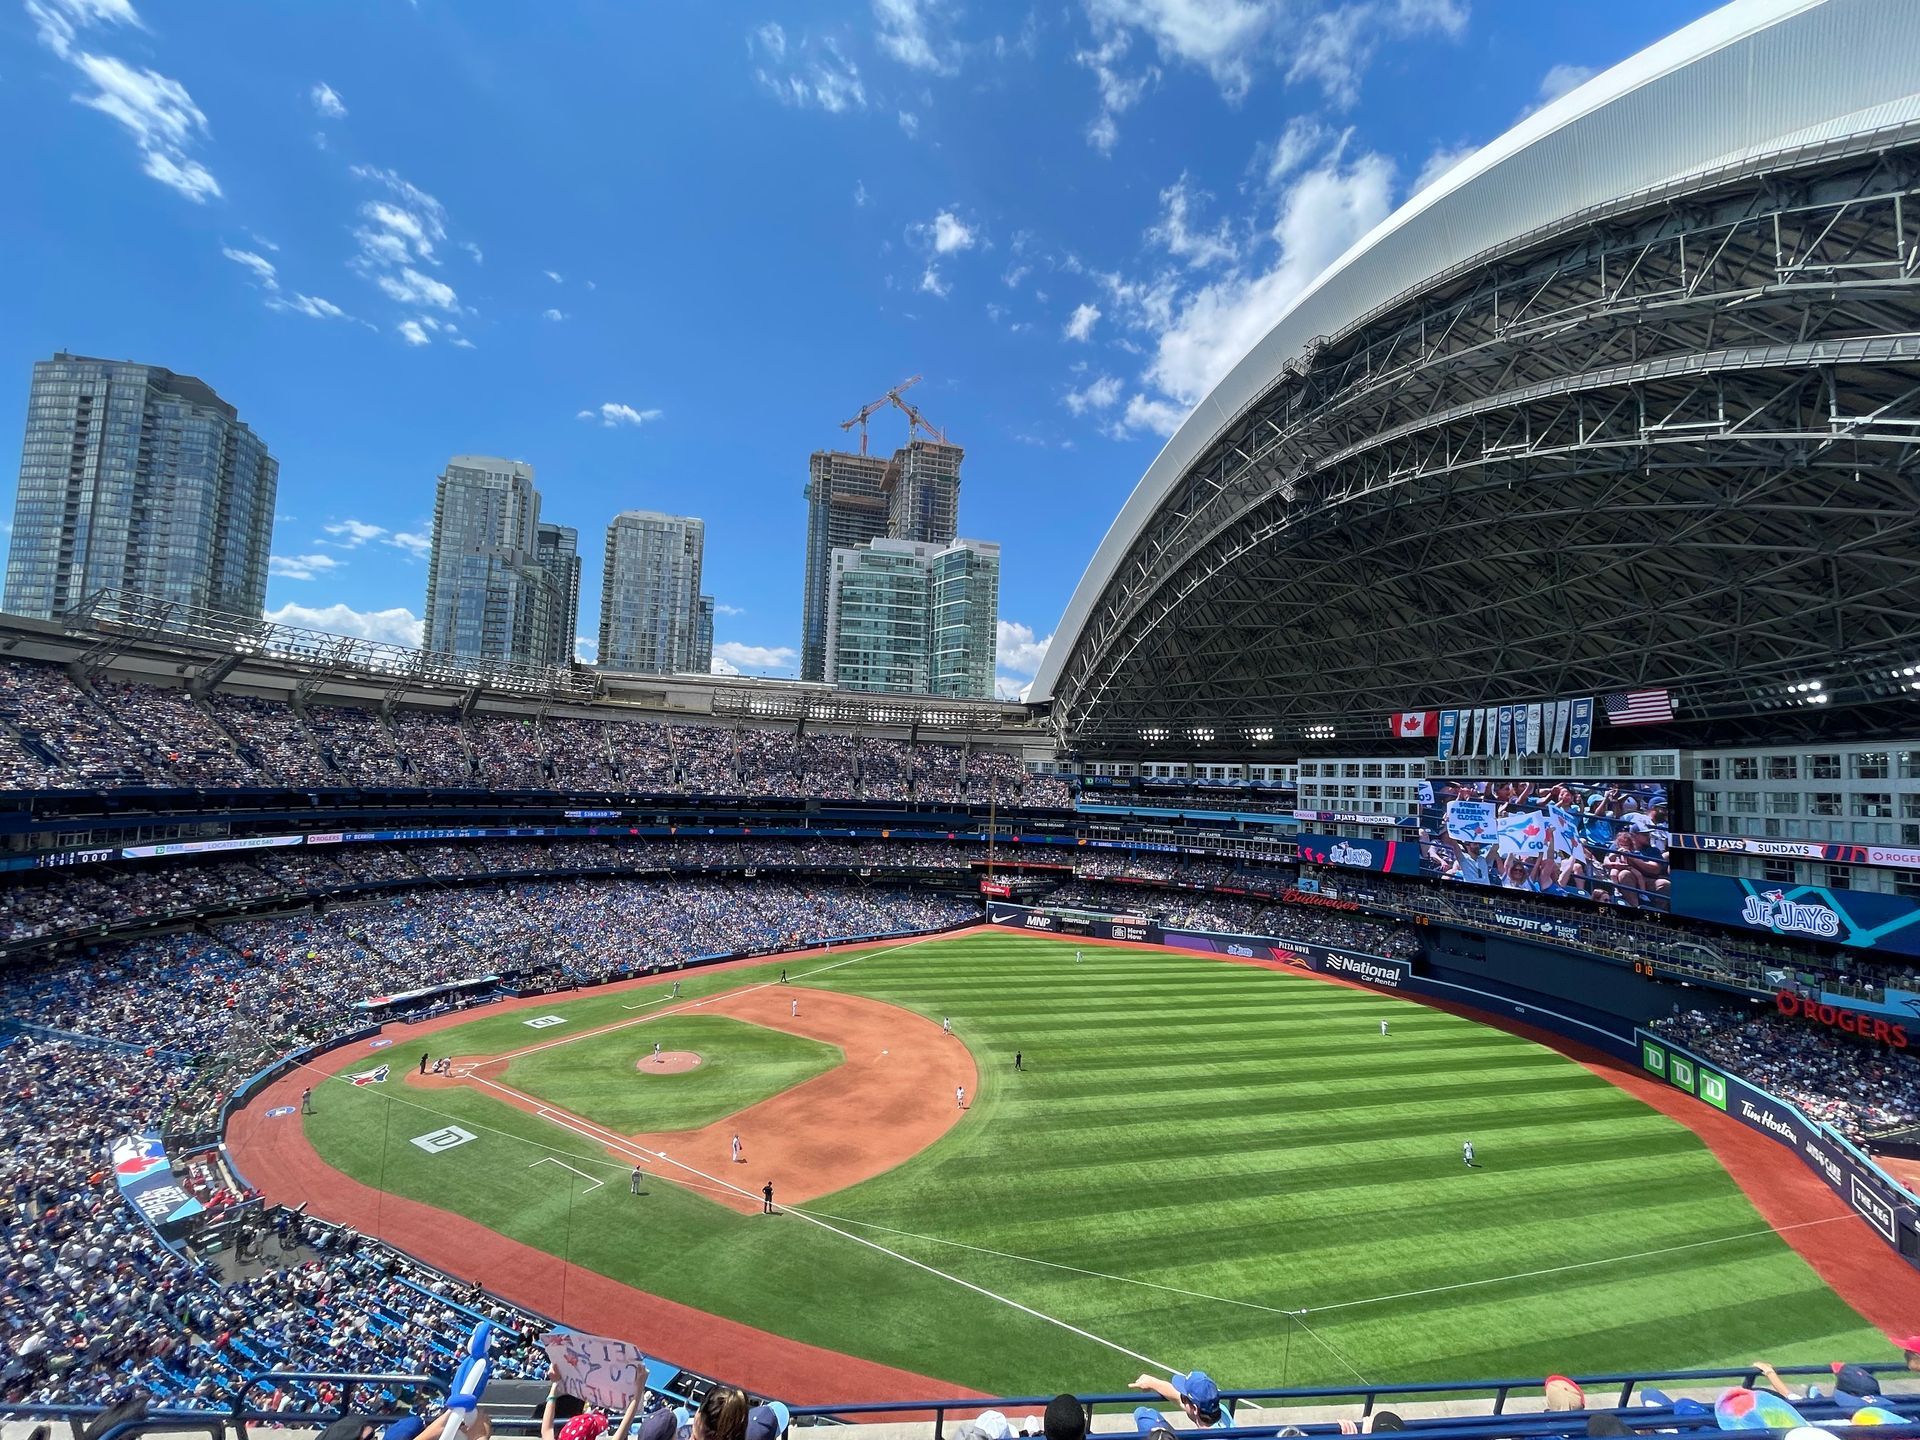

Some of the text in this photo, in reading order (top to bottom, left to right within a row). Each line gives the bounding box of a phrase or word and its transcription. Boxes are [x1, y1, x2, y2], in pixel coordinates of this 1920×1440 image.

[1572, 723, 1590, 738] 32
[208, 841, 239, 849] LOCATED
[1528, 841, 1543, 850] GO
[1703, 838, 1717, 848] JR
[1717, 839, 1744, 850] JAYS
[1758, 843, 1810, 854] SUNDAYS
[1280, 888, 1361, 911] Budweiser
[1026, 915, 1051, 927] MNP
[1495, 914, 1541, 930] WESTJET
[1775, 900, 1839, 936] JAYS
[1554, 925, 1578, 934] FLIGHT
[1279, 941, 1310, 954] PIZZA NOVA
[1361, 974, 1398, 988] Car Rental
[1804, 1001, 1908, 1049] ROGERS
[1645, 1046, 1663, 1070] TD
[1672, 1060, 1691, 1085] TD
[1702, 1073, 1724, 1101] TD
[1741, 1099, 1762, 1123] Tim
[427, 1130, 463, 1147] TD
[151, 1185, 184, 1204] NEXT
[1855, 1187, 1872, 1210] THE
[1872, 1203, 1889, 1226] KEG
